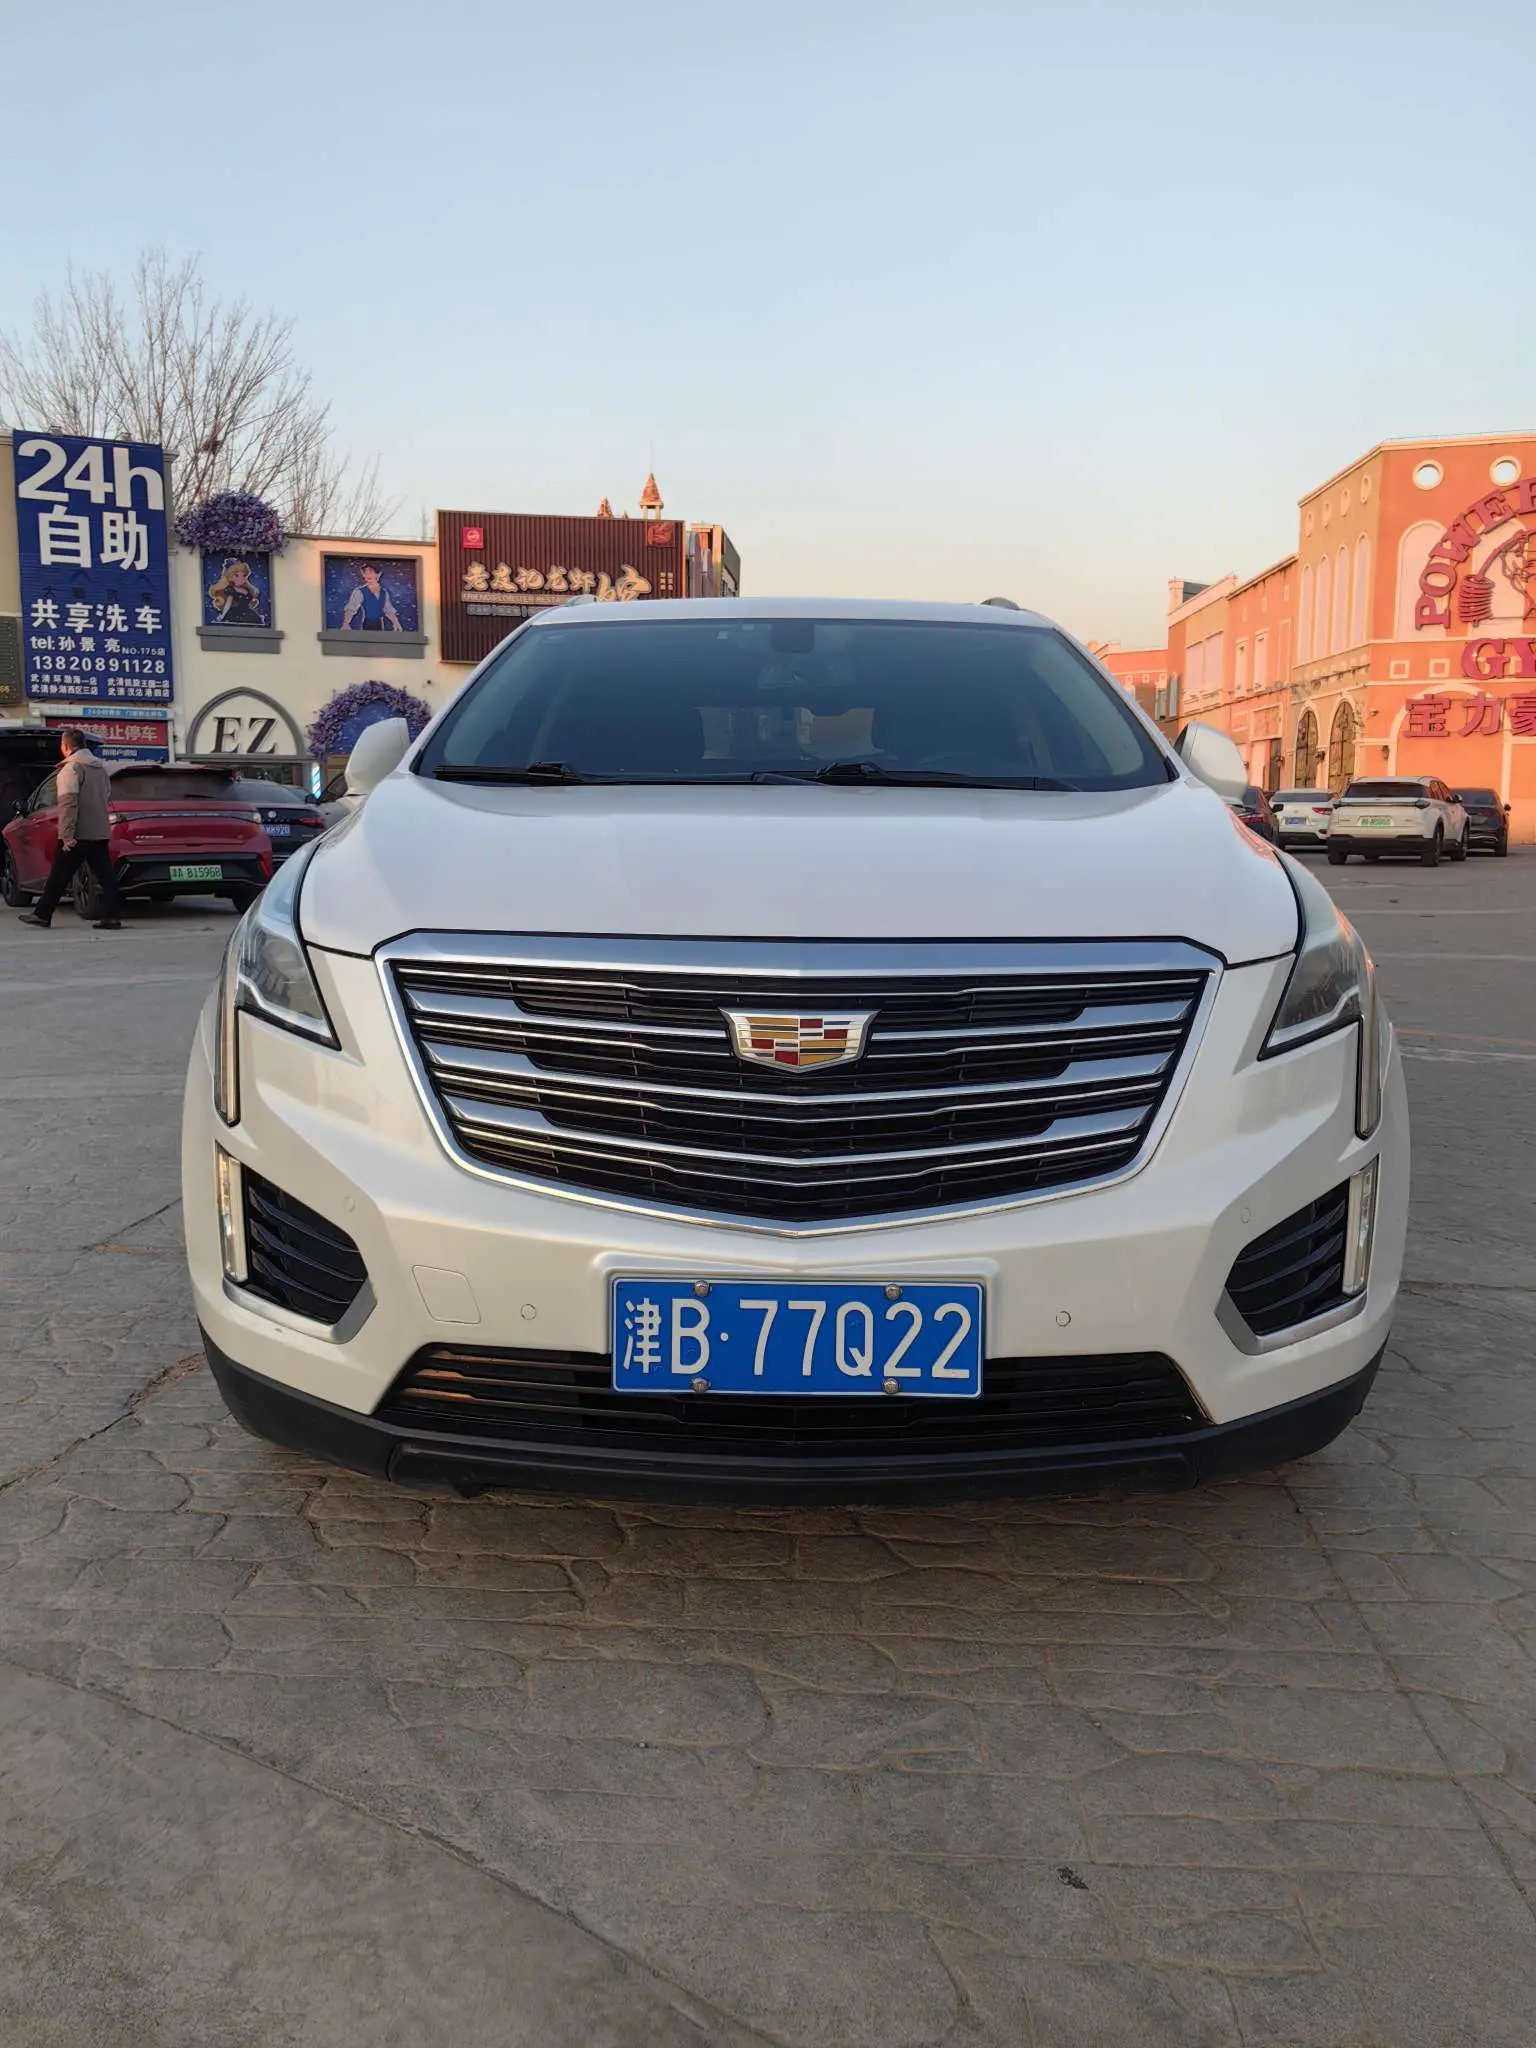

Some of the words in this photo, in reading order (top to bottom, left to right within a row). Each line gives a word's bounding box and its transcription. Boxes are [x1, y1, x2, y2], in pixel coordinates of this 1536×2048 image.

[18, 439, 164, 510] 24h
[38, 504, 149, 571] 自助
[30, 598, 162, 634] 共享洗车
[33, 655, 165, 674] 13820891128
[210, 717, 278, 754] EZ
[623, 1297, 972, 1379] 津B·77Q22
